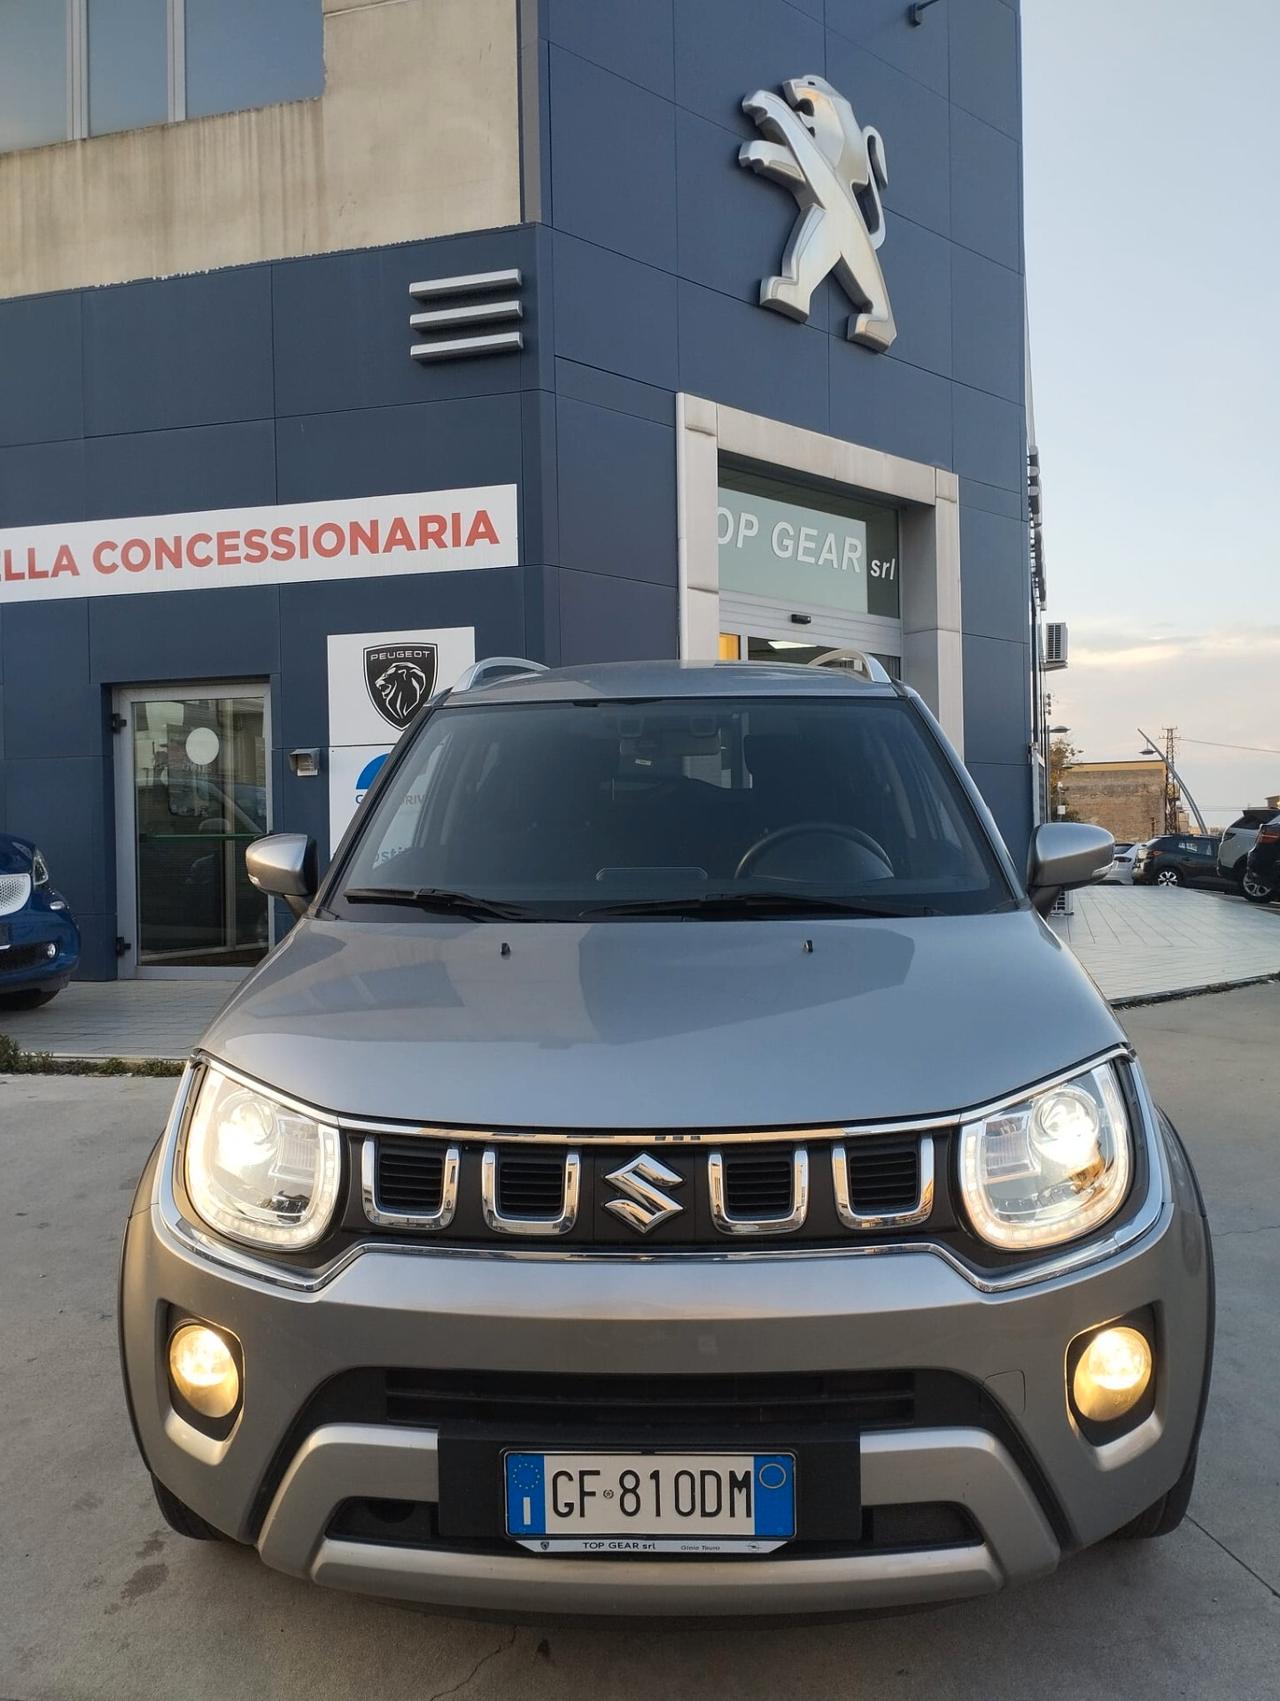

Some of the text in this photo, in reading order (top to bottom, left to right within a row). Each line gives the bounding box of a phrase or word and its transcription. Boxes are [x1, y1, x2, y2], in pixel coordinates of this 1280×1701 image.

[0, 509, 500, 581] LLA CONCESSIONARIA
[717, 507, 896, 580] OP GEAR srl
[370, 650, 431, 661] PEUGEOT
[552, 1470, 600, 1518] GF
[583, 1541, 656, 1550] TOP GEAR srl
